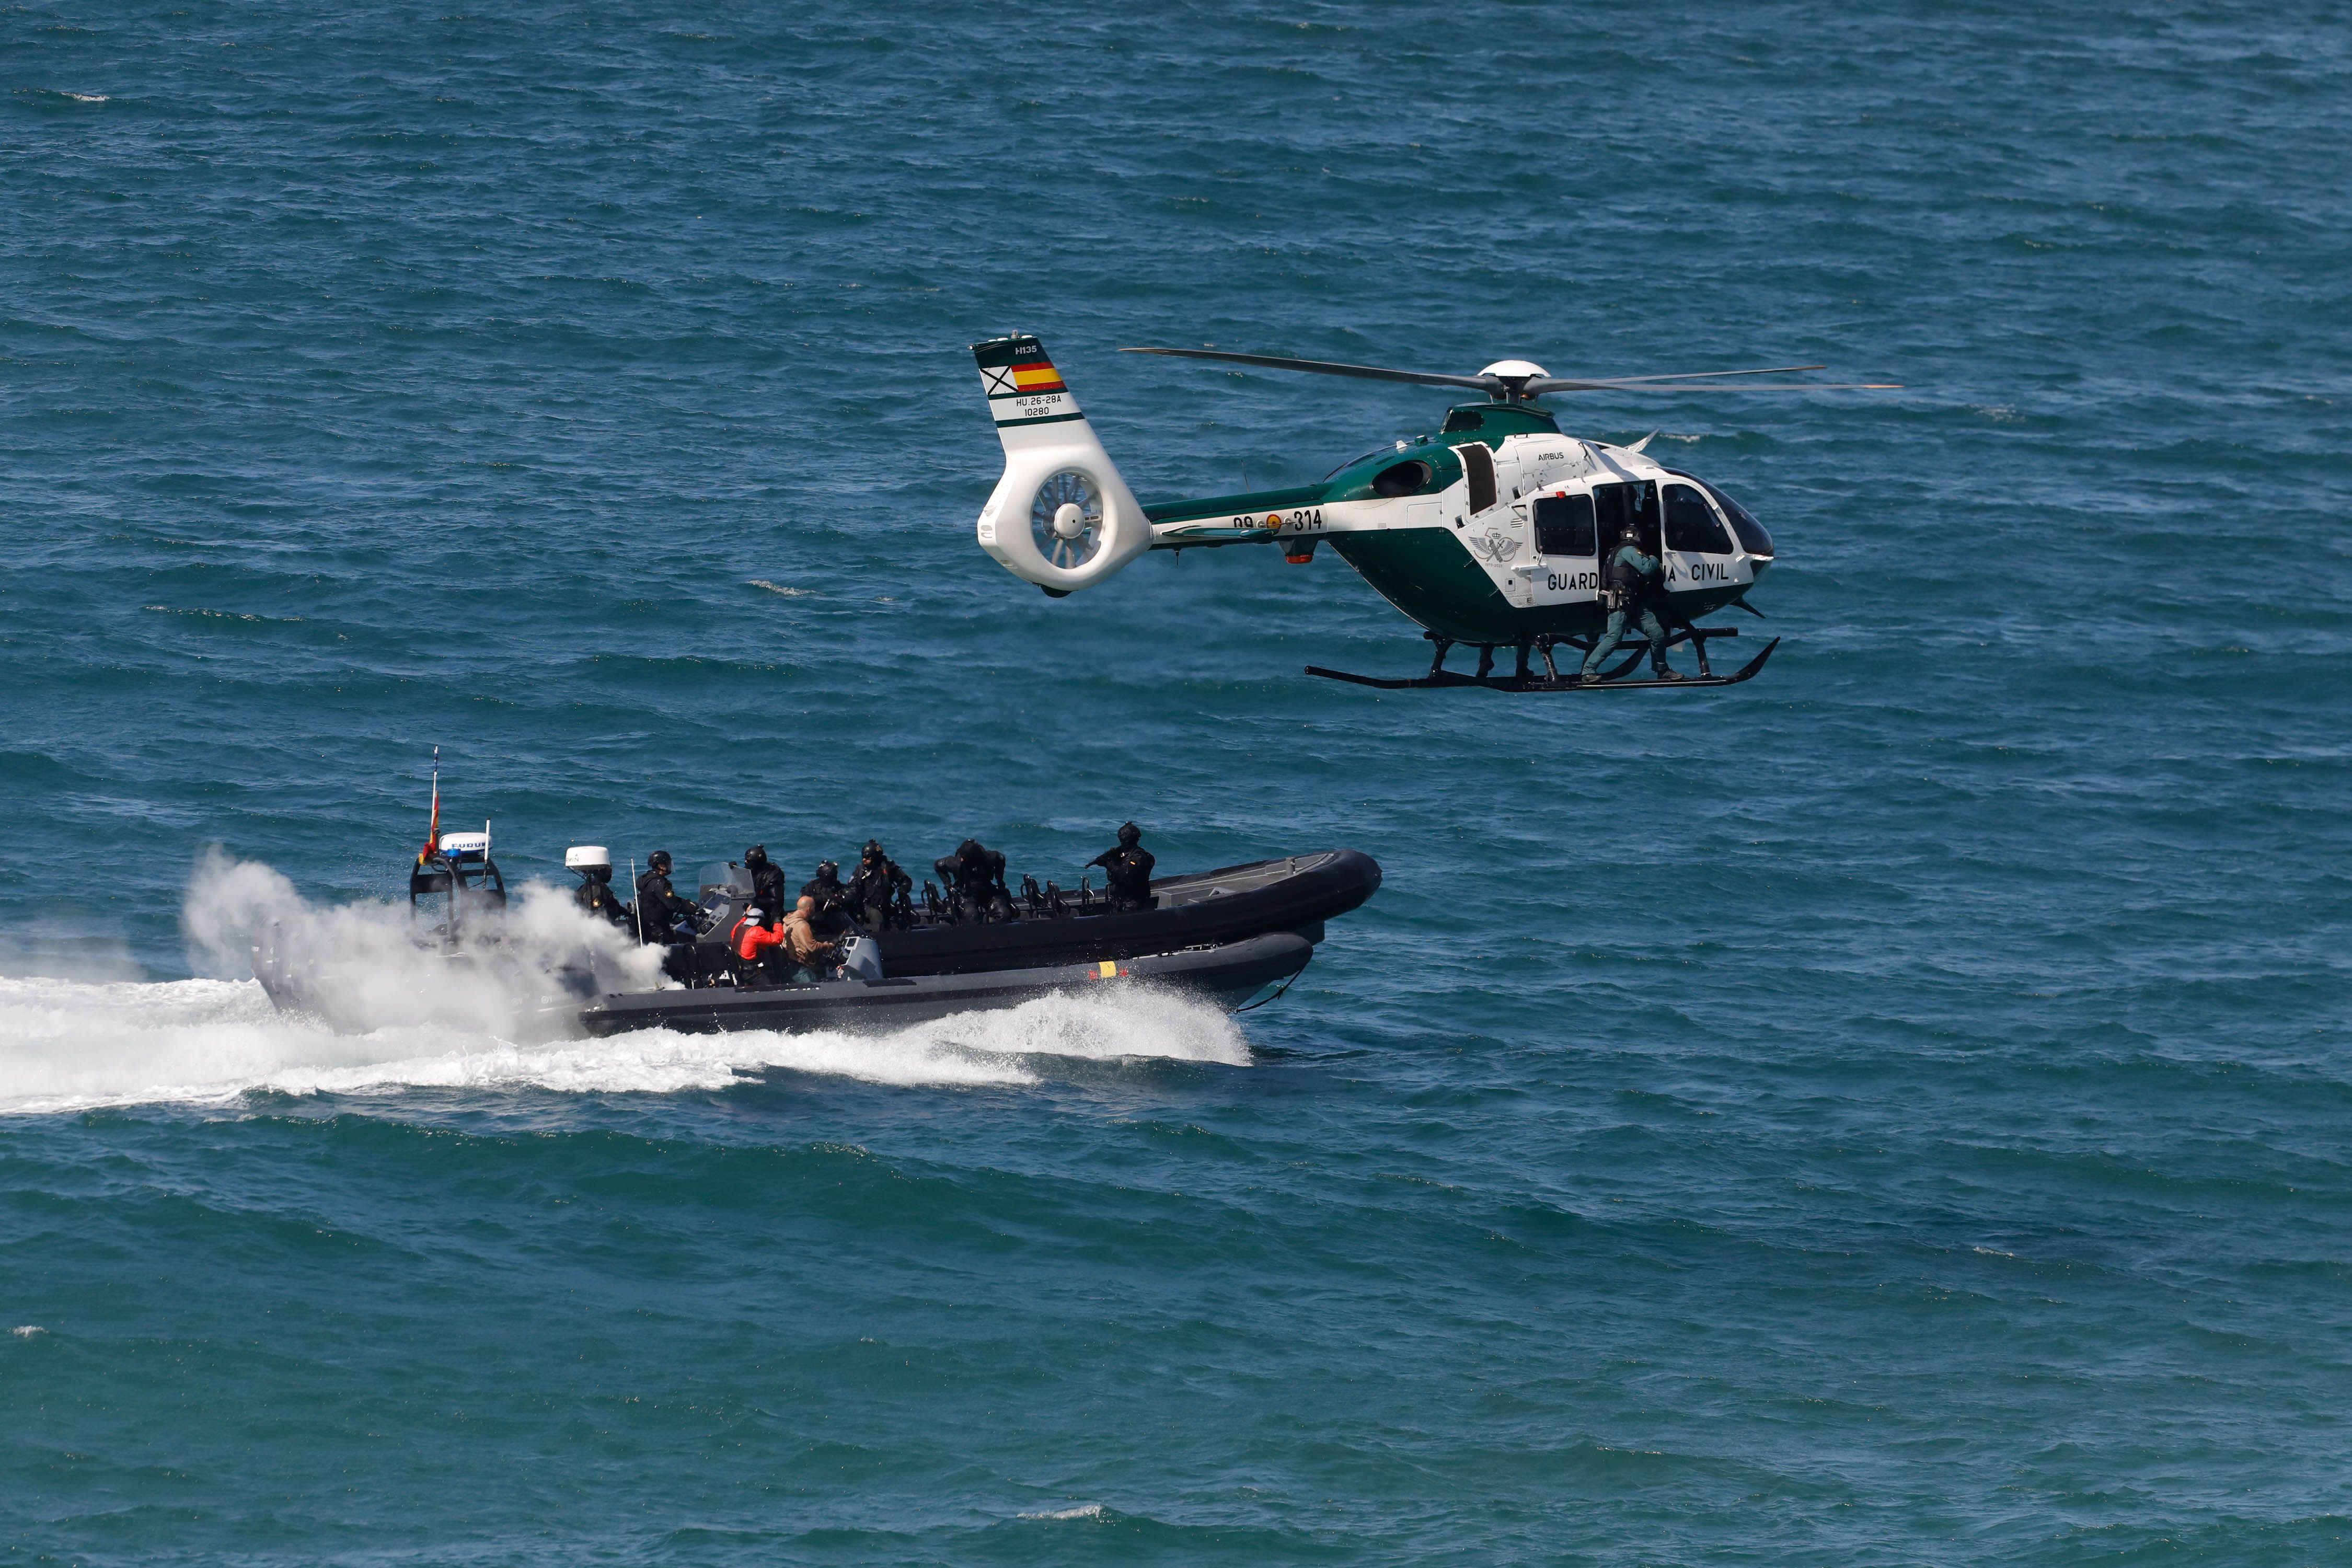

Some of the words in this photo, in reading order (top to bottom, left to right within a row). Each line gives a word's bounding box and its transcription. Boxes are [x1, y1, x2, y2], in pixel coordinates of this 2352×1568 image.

[1015, 345, 1037, 355] H135
[1016, 395, 1062, 407] HU.26-28A
[1024, 407, 1049, 416] 10280
[1538, 452, 1564, 460] AIRBUS
[1294, 509, 1322, 531] 314
[1691, 563, 1729, 581] CIVIL
